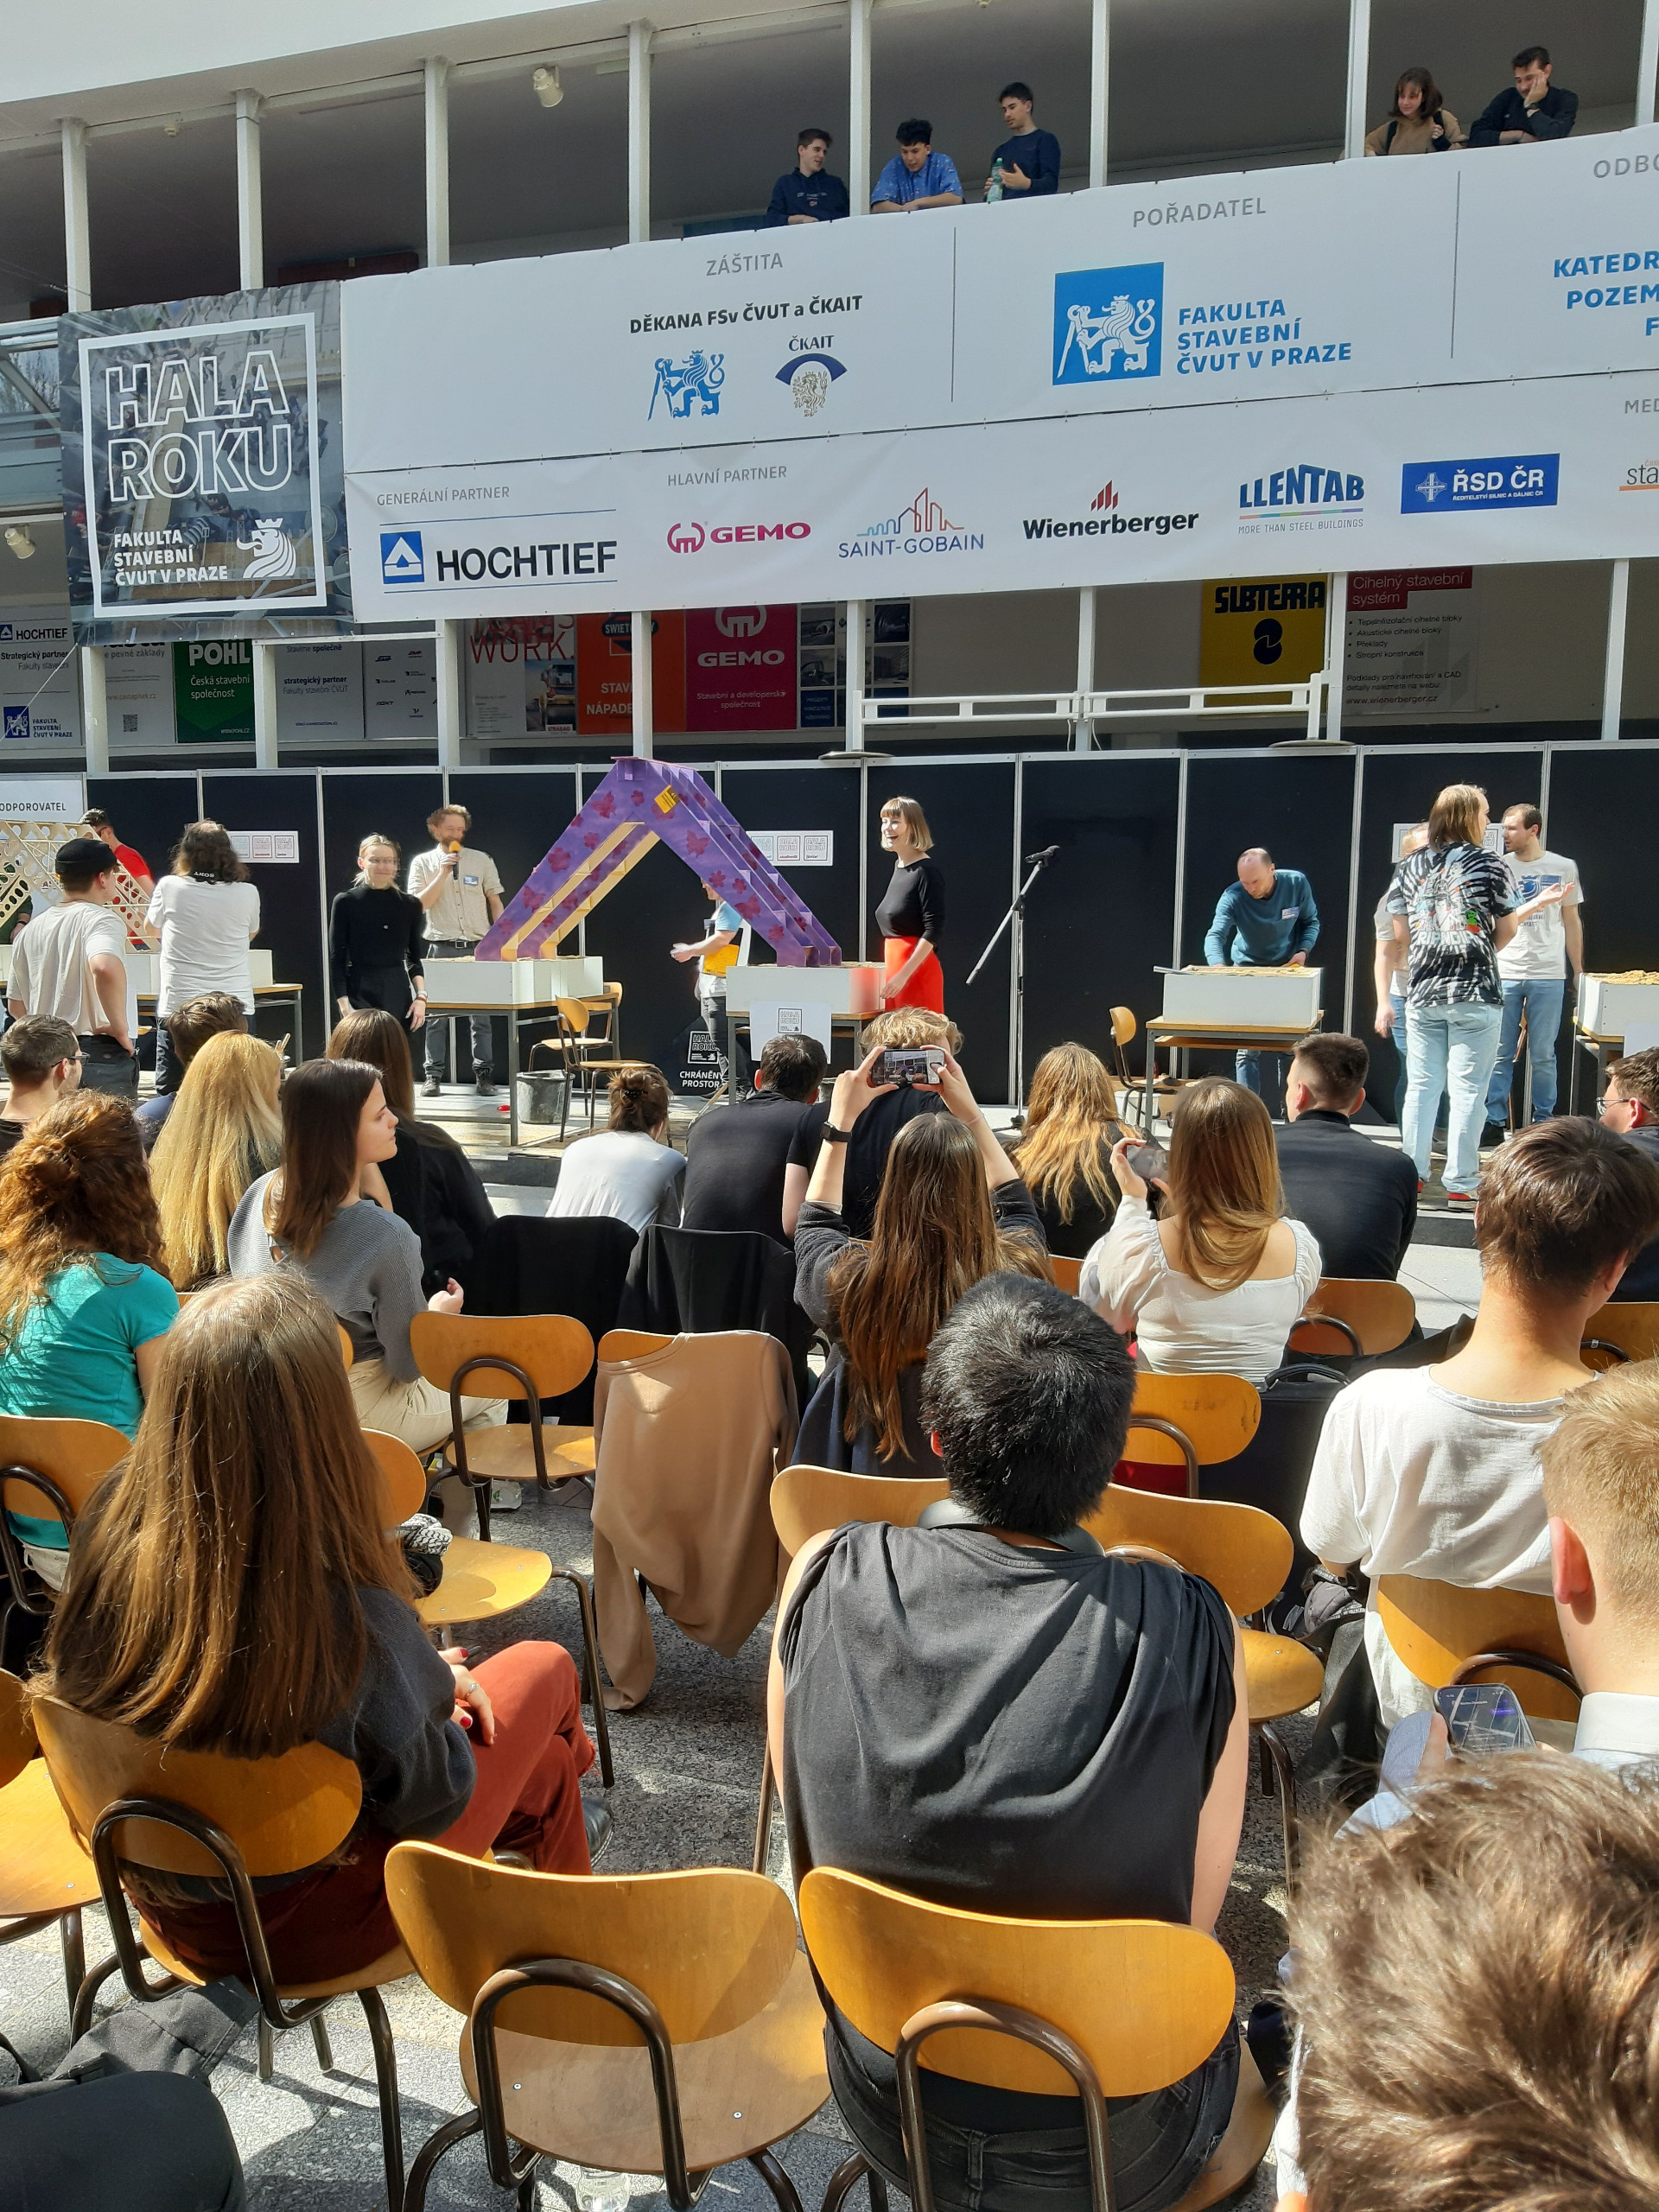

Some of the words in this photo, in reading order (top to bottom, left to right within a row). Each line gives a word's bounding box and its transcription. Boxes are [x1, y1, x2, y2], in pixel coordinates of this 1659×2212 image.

[1132, 197, 1267, 228] POŘADATEL
[706, 252, 784, 276] ZÁŠTITA
[1554, 251, 1659, 278] KATEDR
[1567, 283, 1659, 309] POZEM
[630, 311, 703, 334] DĚKANA
[708, 308, 738, 327] FSv
[742, 302, 790, 323] ČVUT
[793, 304, 804, 317] a
[809, 295, 863, 315] ČKAIT
[1178, 299, 1286, 326] FAKULTA
[788, 334, 835, 352] ČKAIT
[1177, 317, 1302, 351] STAVEBNÍ
[1176, 352, 1239, 375] ČVUT
[1247, 351, 1263, 369] V
[1271, 342, 1353, 367] PRAZE
[105, 350, 291, 429] HALA
[107, 423, 294, 503] ROKU
[667, 469, 721, 486] HLAVNÍ
[723, 466, 787, 483] PARTNER
[1239, 464, 1365, 508] LLENTAB
[1452, 468, 1503, 493] ŘSD
[1510, 465, 1544, 489] ČR
[377, 488, 449, 506] GENERÁLNÍ
[452, 486, 510, 502] PARTNER
[710, 522, 811, 544] GEMO
[1023, 512, 1199, 540] Wienerberger
[1238, 525, 1261, 535] MORE
[1265, 524, 1286, 533] THAN
[1289, 521, 1314, 531] STEEL
[1318, 518, 1363, 530] BUILDINGS
[114, 530, 183, 548] FAKULTA
[838, 534, 984, 558] SAINT-GOBAIN
[114, 544, 194, 567] STAVEBNÍ
[436, 541, 617, 582] HOCHTIEF
[115, 568, 156, 586] ČVUT
[160, 569, 171, 583] V
[176, 565, 228, 582] PRAZE
[1353, 575, 1402, 590] Cihelný
[1407, 571, 1465, 587] stavební
[1352, 592, 1401, 607] systém
[16, 628, 68, 639] HOCHTIEF
[1, 651, 41, 660] Strategický
[136, 649, 165, 658] základy
[188, 642, 251, 666] POHL
[313, 644, 342, 653] společně
[470, 632, 575, 664] WORK.
[18, 662, 40, 671] Fakulty
[697, 650, 785, 667] GEMO
[190, 675, 214, 686] Česká
[215, 674, 250, 685] stavební
[283, 677, 321, 685] strategický
[322, 676, 347, 684] partner
[1346, 674, 1380, 683] Podklady
[191, 689, 235, 701] společnost
[736, 690, 786, 699] developerská
[1345, 695, 1438, 704] www.wienerberger.cz
[721, 701, 760, 709] společnost
